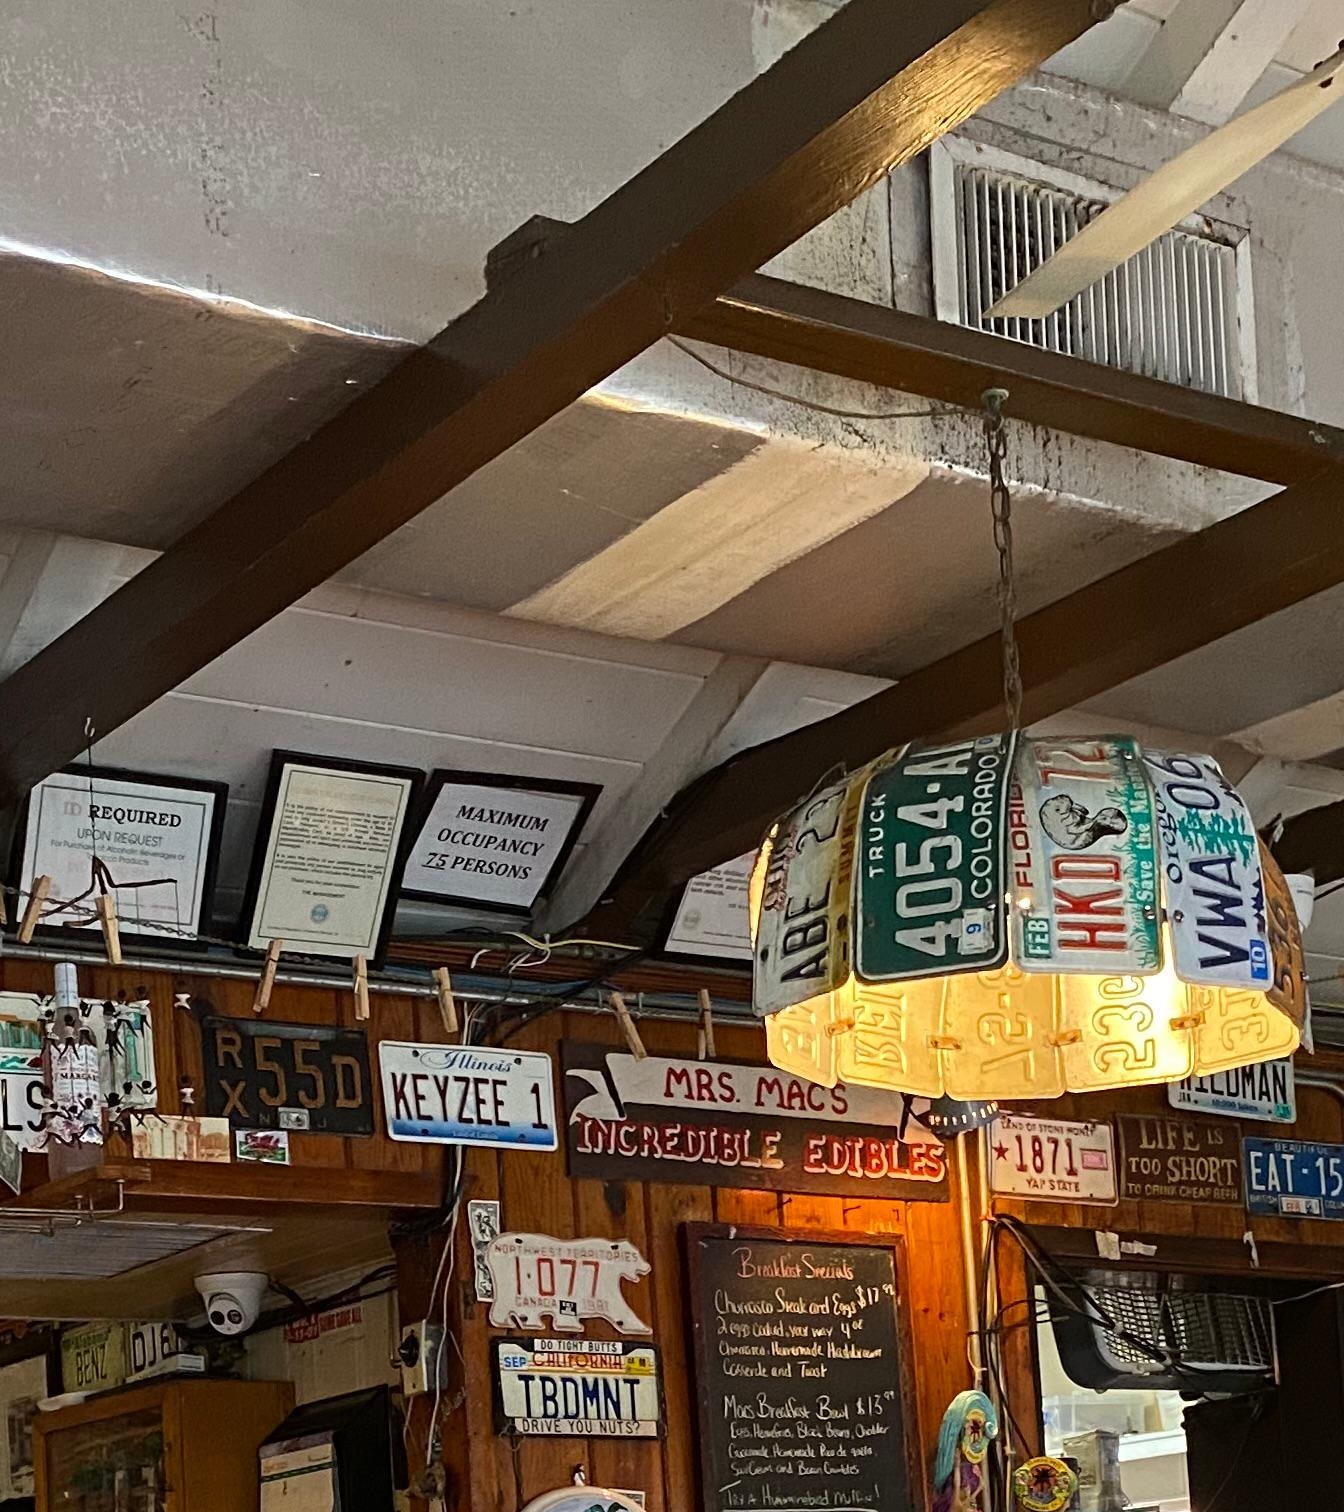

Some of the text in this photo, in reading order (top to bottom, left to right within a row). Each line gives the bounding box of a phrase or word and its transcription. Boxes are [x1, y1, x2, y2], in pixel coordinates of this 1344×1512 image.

[89, 805, 182, 828] REQUIRED
[455, 805, 550, 832] MAXIMUM
[970, 754, 998, 899] COLORADO
[77, 828, 164, 848] UPON REQUEST
[437, 829, 545, 857] OCCUPANCY
[869, 793, 887, 877] TRUCK
[421, 852, 532, 881] 75 PERSONS
[1133, 823, 1155, 902] Save the
[1050, 855, 1128, 952] HKD
[1188, 855, 1250, 969] VWA
[1028, 920, 1049, 955] FEB
[1251, 946, 1266, 972] 10
[256, 1038, 363, 1110] 55D
[420, 1046, 513, 1074] Illinois
[392, 1072, 549, 1130] KEYZEE 1
[664, 1067, 740, 1104] MRS.
[576, 1112, 947, 1183] INCREDIBLE EDIBLES
[1139, 1119, 1224, 1152] LIFE IS
[1015, 1134, 1079, 1177] 1871
[1128, 1155, 1238, 1186] TOO SHORT
[1048, 1179, 1081, 1193] STATE
[1127, 1181, 1212, 1199] TO DRINK CHEAP
[731, 1247, 801, 1278] Breakfast
[504, 1353, 623, 1369] SEP CALIFORNIA
[540, 1340, 618, 1353] DO TIGHT BUTTS
[75, 1342, 107, 1384] BENZ
[517, 1374, 640, 1422] TBDMNT
[522, 1420, 641, 1435] DRIVE YOU NUTS?
